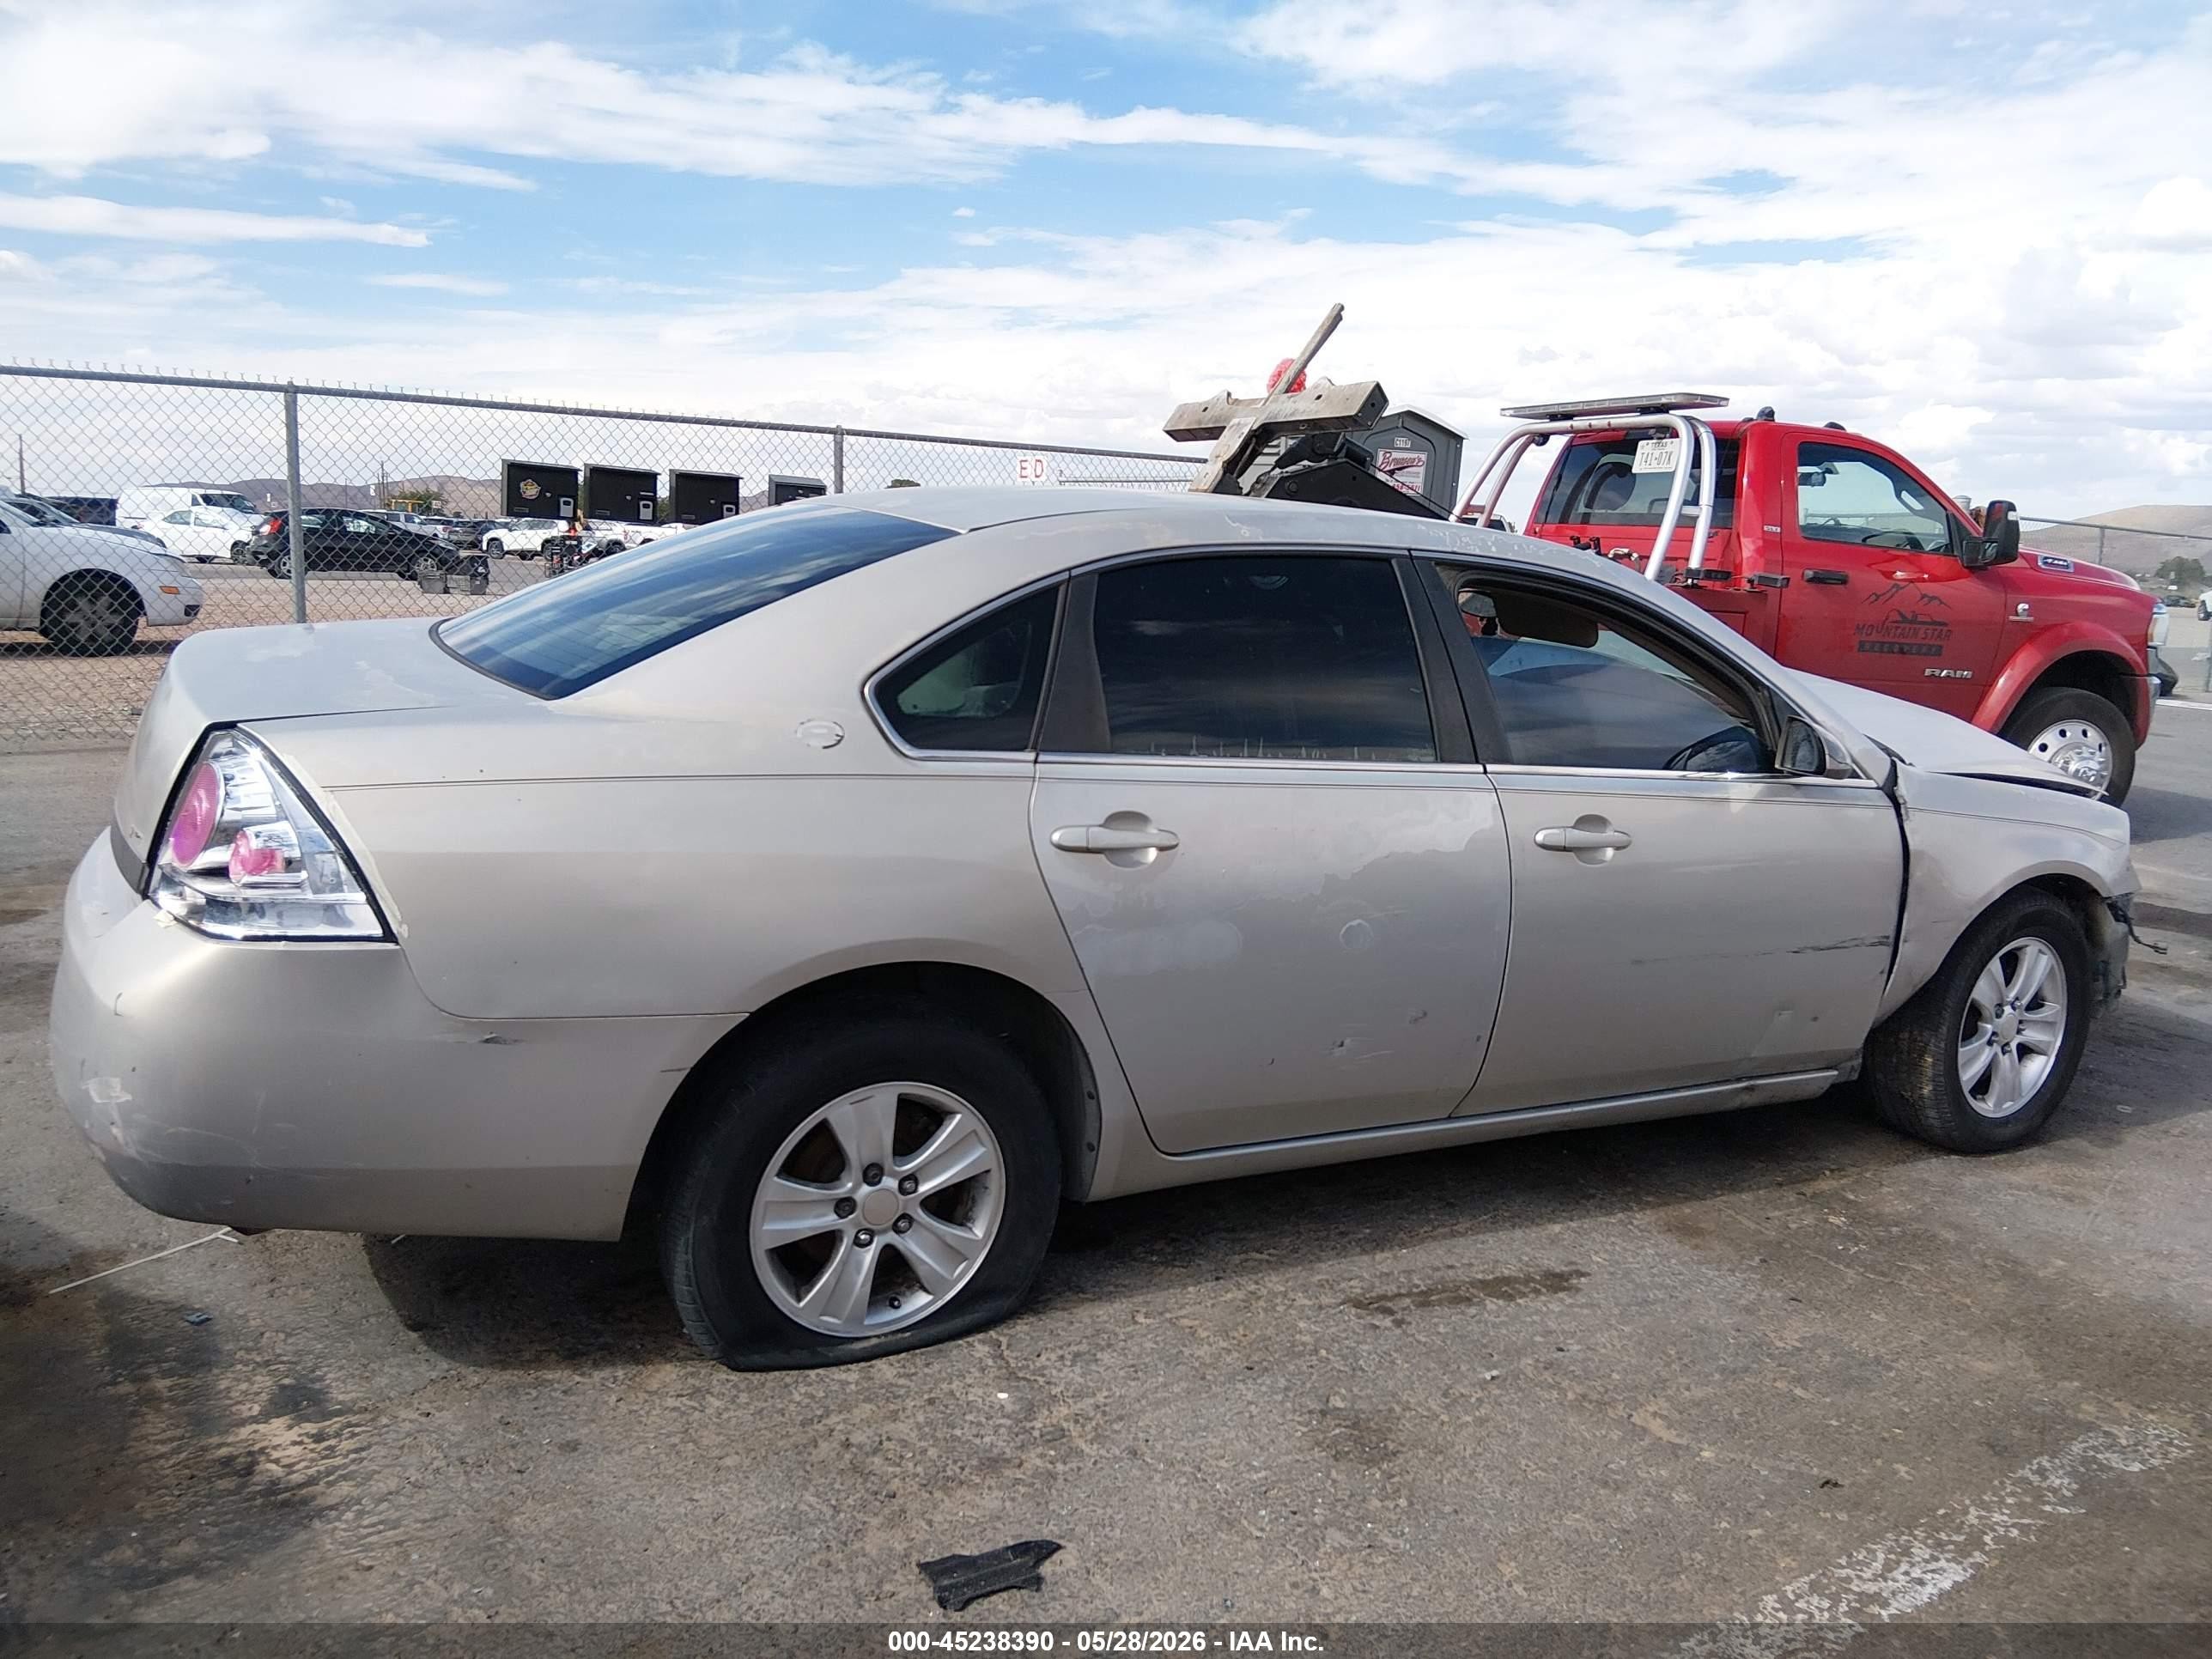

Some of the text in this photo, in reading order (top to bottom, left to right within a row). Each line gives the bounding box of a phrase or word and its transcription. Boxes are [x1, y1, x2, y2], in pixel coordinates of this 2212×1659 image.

[1854, 623, 1952, 641] MOUNTAIN STAR
[1924, 668, 1972, 679] RAM
